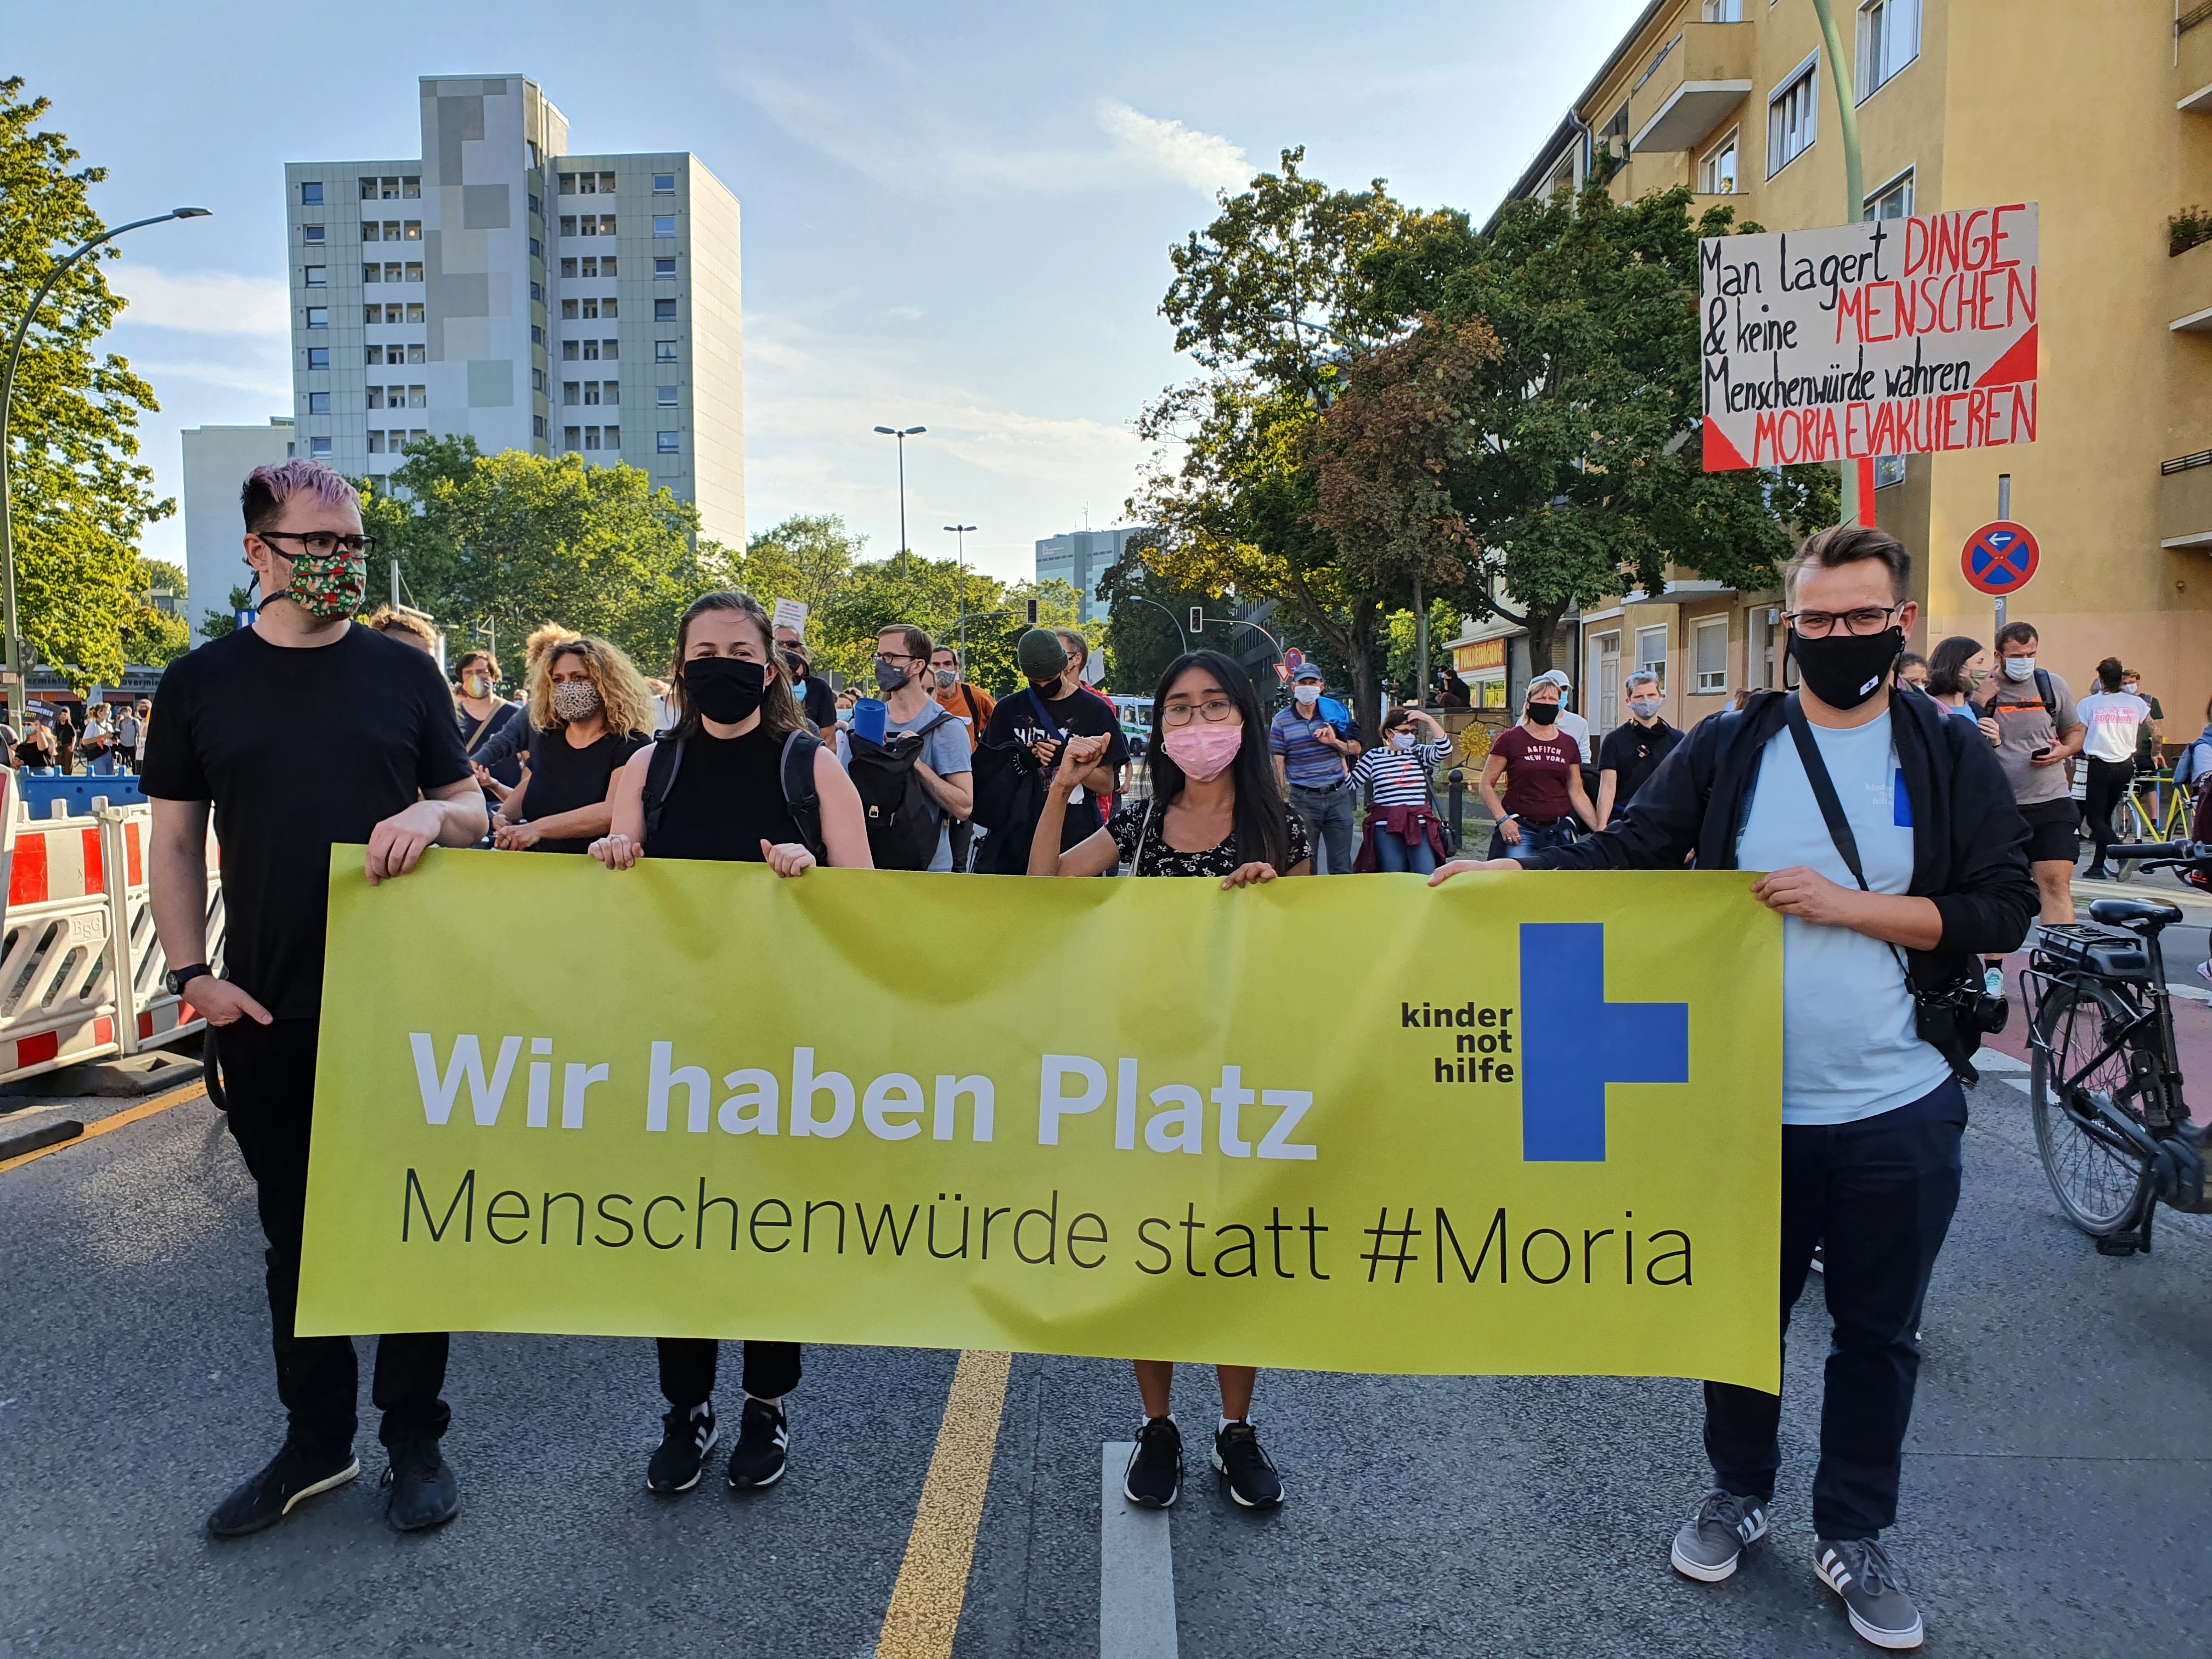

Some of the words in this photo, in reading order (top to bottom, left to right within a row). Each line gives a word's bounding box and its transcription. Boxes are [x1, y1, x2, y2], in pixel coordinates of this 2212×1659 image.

[1701, 239, 1761, 297] Man
[1780, 221, 1888, 311] lagert
[1904, 204, 2025, 277] DINGE
[1703, 296, 1727, 356] &
[1736, 296, 1797, 354] keine
[1836, 266, 2036, 344] MENSCHEN
[1705, 344, 1875, 416] Menschenwürde
[1884, 336, 1971, 398] wahren
[1752, 407, 1839, 468] MORIA
[1845, 383, 2037, 460] EVAKUIEREN
[1460, 642, 1503, 669] VOLLREINIGUNG
[1545, 755, 1566, 764] YORK
[1401, 1002, 1514, 1028] kinder
[1456, 1029, 1513, 1053] not
[409, 1032, 609, 1129] Wir
[646, 1041, 995, 1142] haben
[1038, 1053, 1317, 1160] Platz
[1434, 1057, 1514, 1084] hilfe
[402, 1167, 1108, 1269] Menschenwürde
[1135, 1201, 1330, 1280] statt
[1359, 1206, 1693, 1286] #Moria
